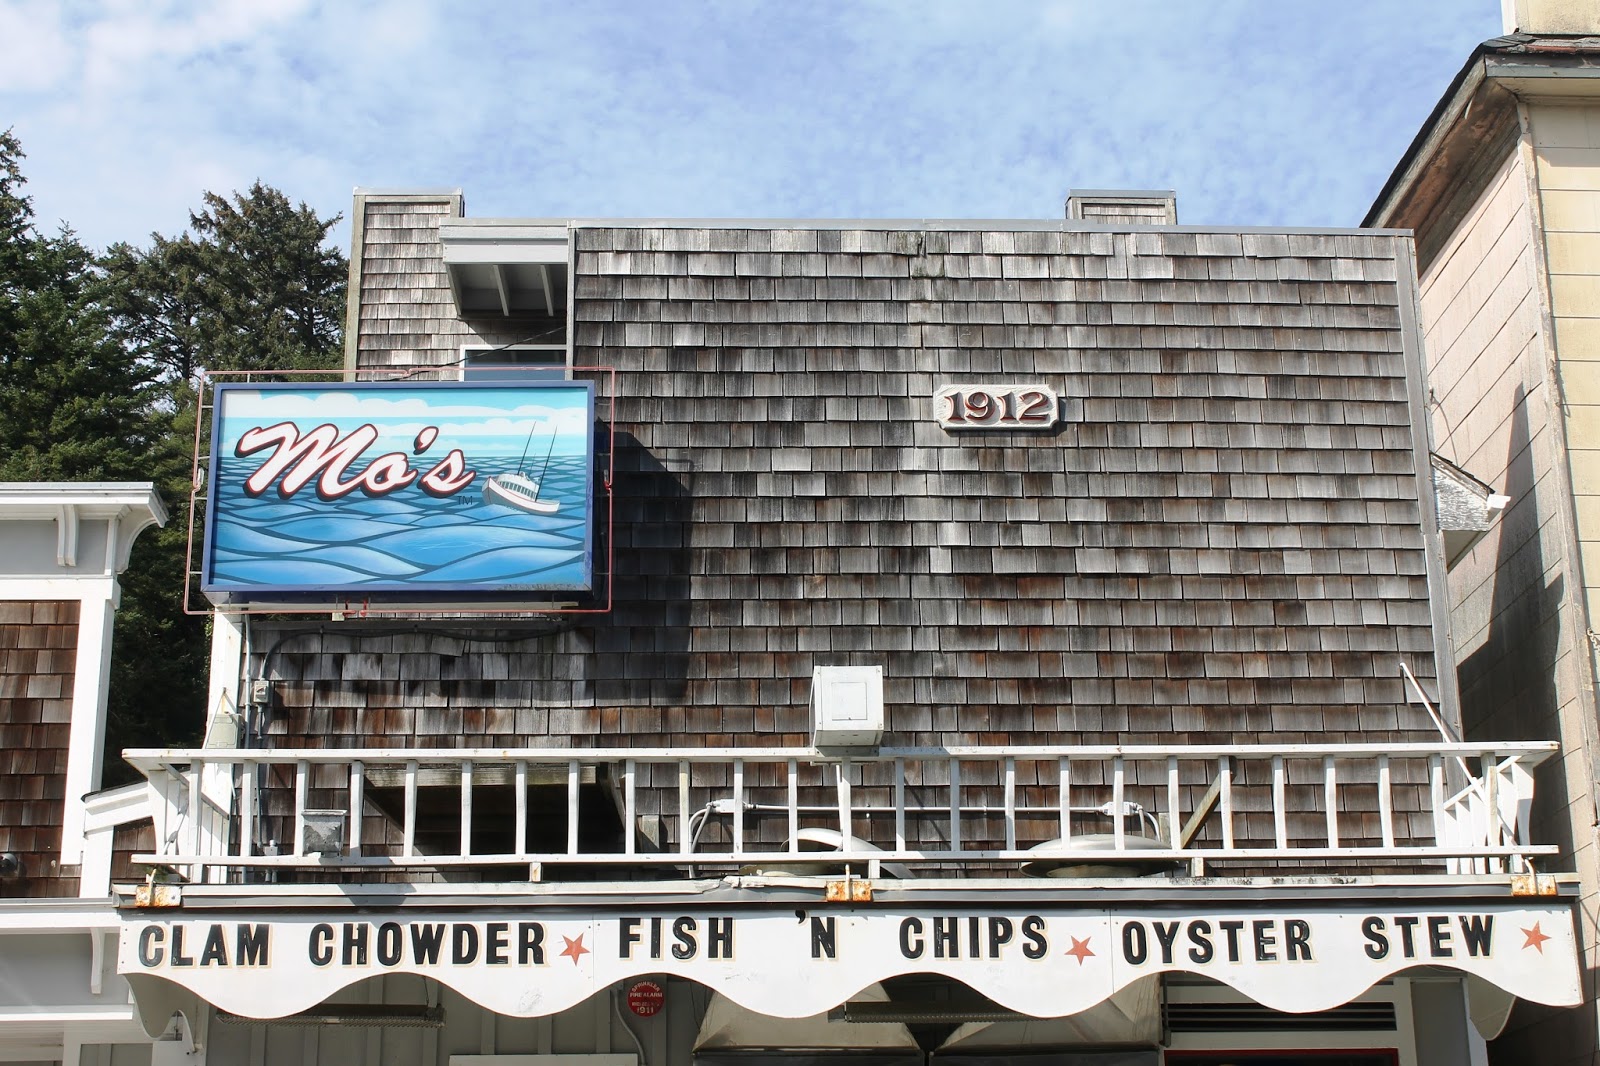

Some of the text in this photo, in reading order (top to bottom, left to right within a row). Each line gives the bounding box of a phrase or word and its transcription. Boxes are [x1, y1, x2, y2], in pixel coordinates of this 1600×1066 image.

[944, 391, 1049, 421] 1912
[234, 421, 476, 502] Mo's
[457, 495, 473, 505] TM
[138, 909, 1495, 968] CLAM CHOWDER FISH 'N CHIPS OYSTER STEW
[631, 981, 661, 992] SPRINKLER
